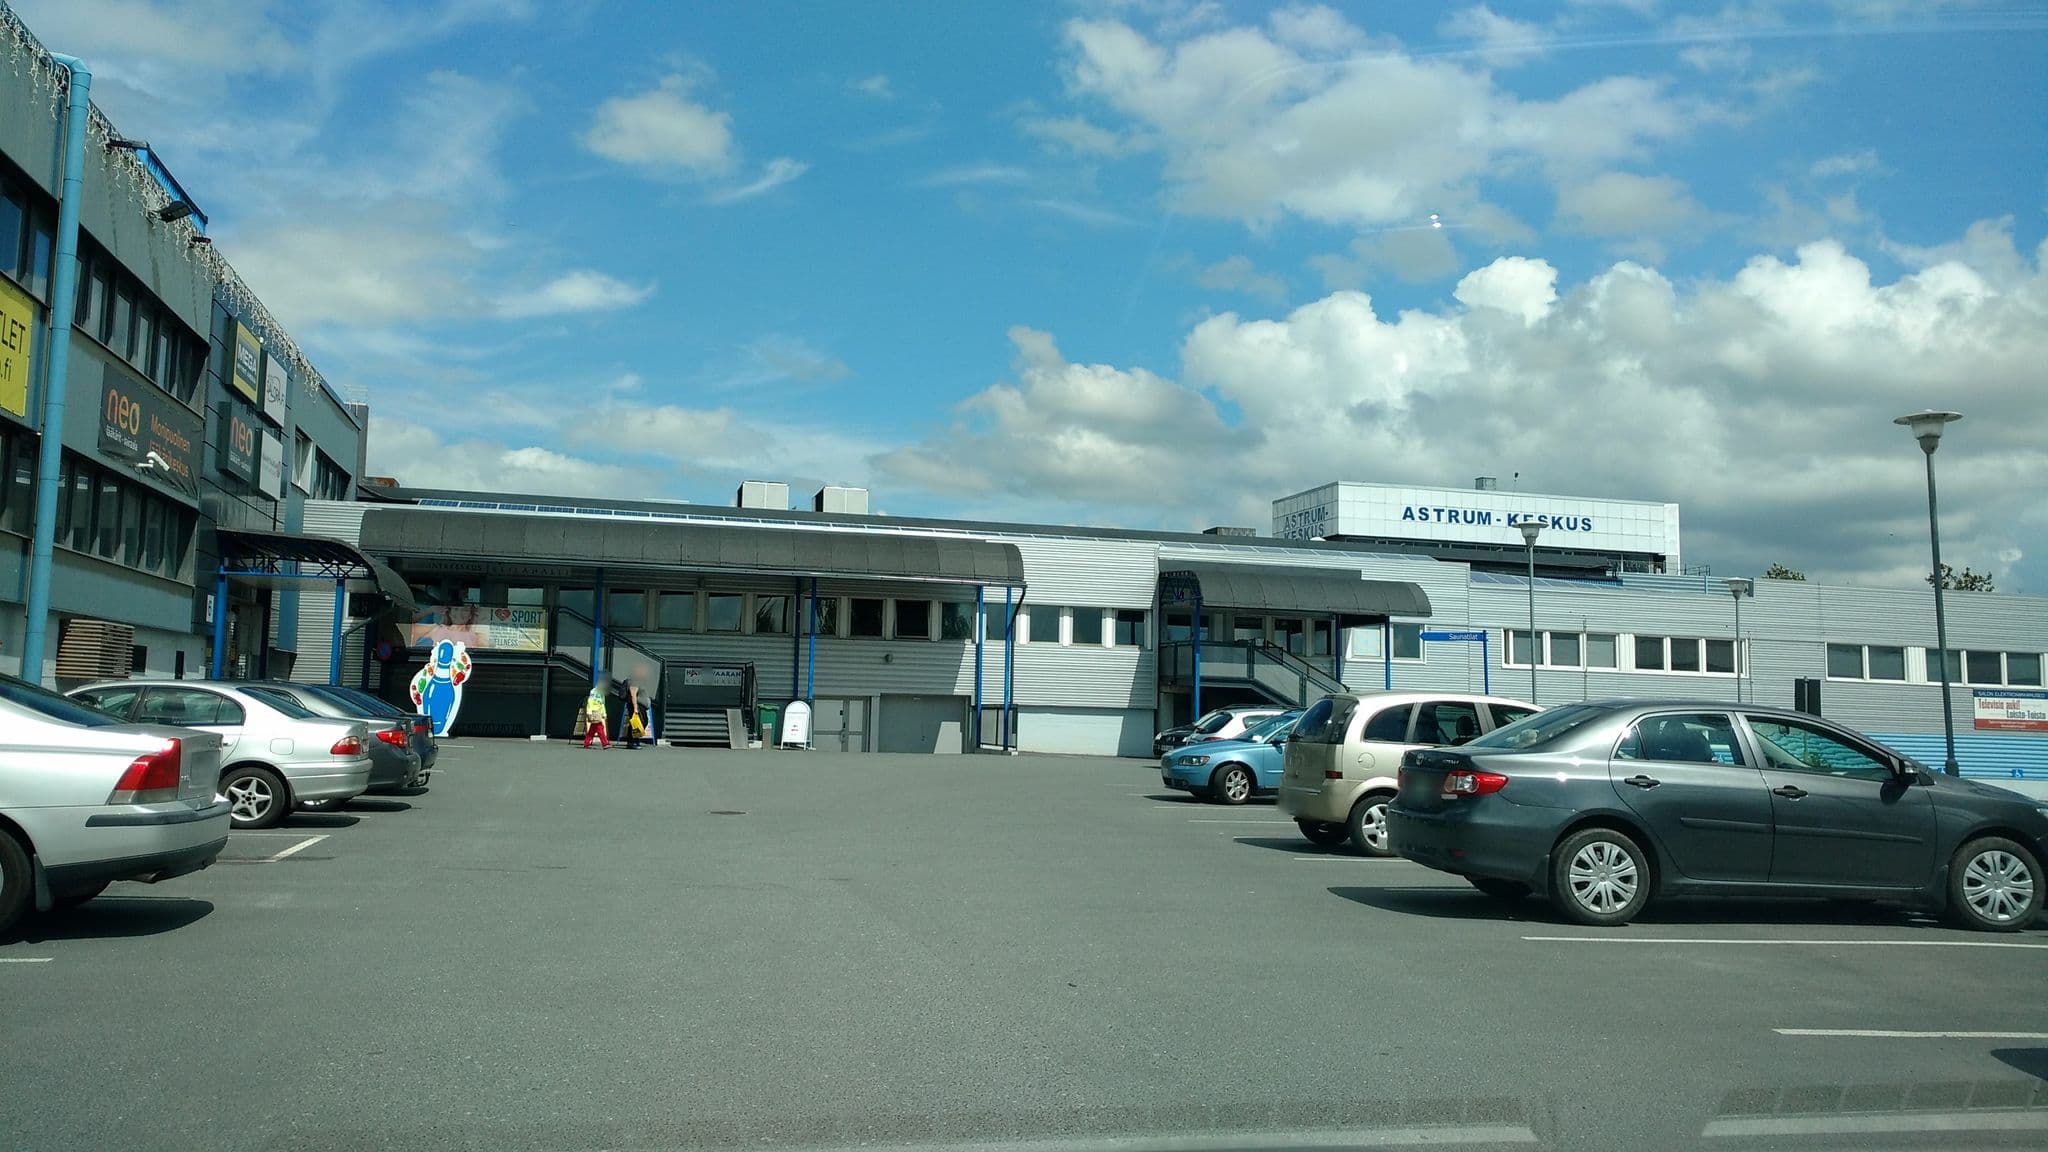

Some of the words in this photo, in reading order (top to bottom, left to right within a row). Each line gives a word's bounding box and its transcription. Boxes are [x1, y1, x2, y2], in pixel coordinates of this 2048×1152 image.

[0, 357, 12, 381] .fi
[107, 388, 140, 435] neo
[230, 416, 253, 457] neo
[1402, 506, 1491, 525] ASTRUM
[1507, 513, 1592, 531] KESKUS
[511, 610, 543, 623] SPORT
